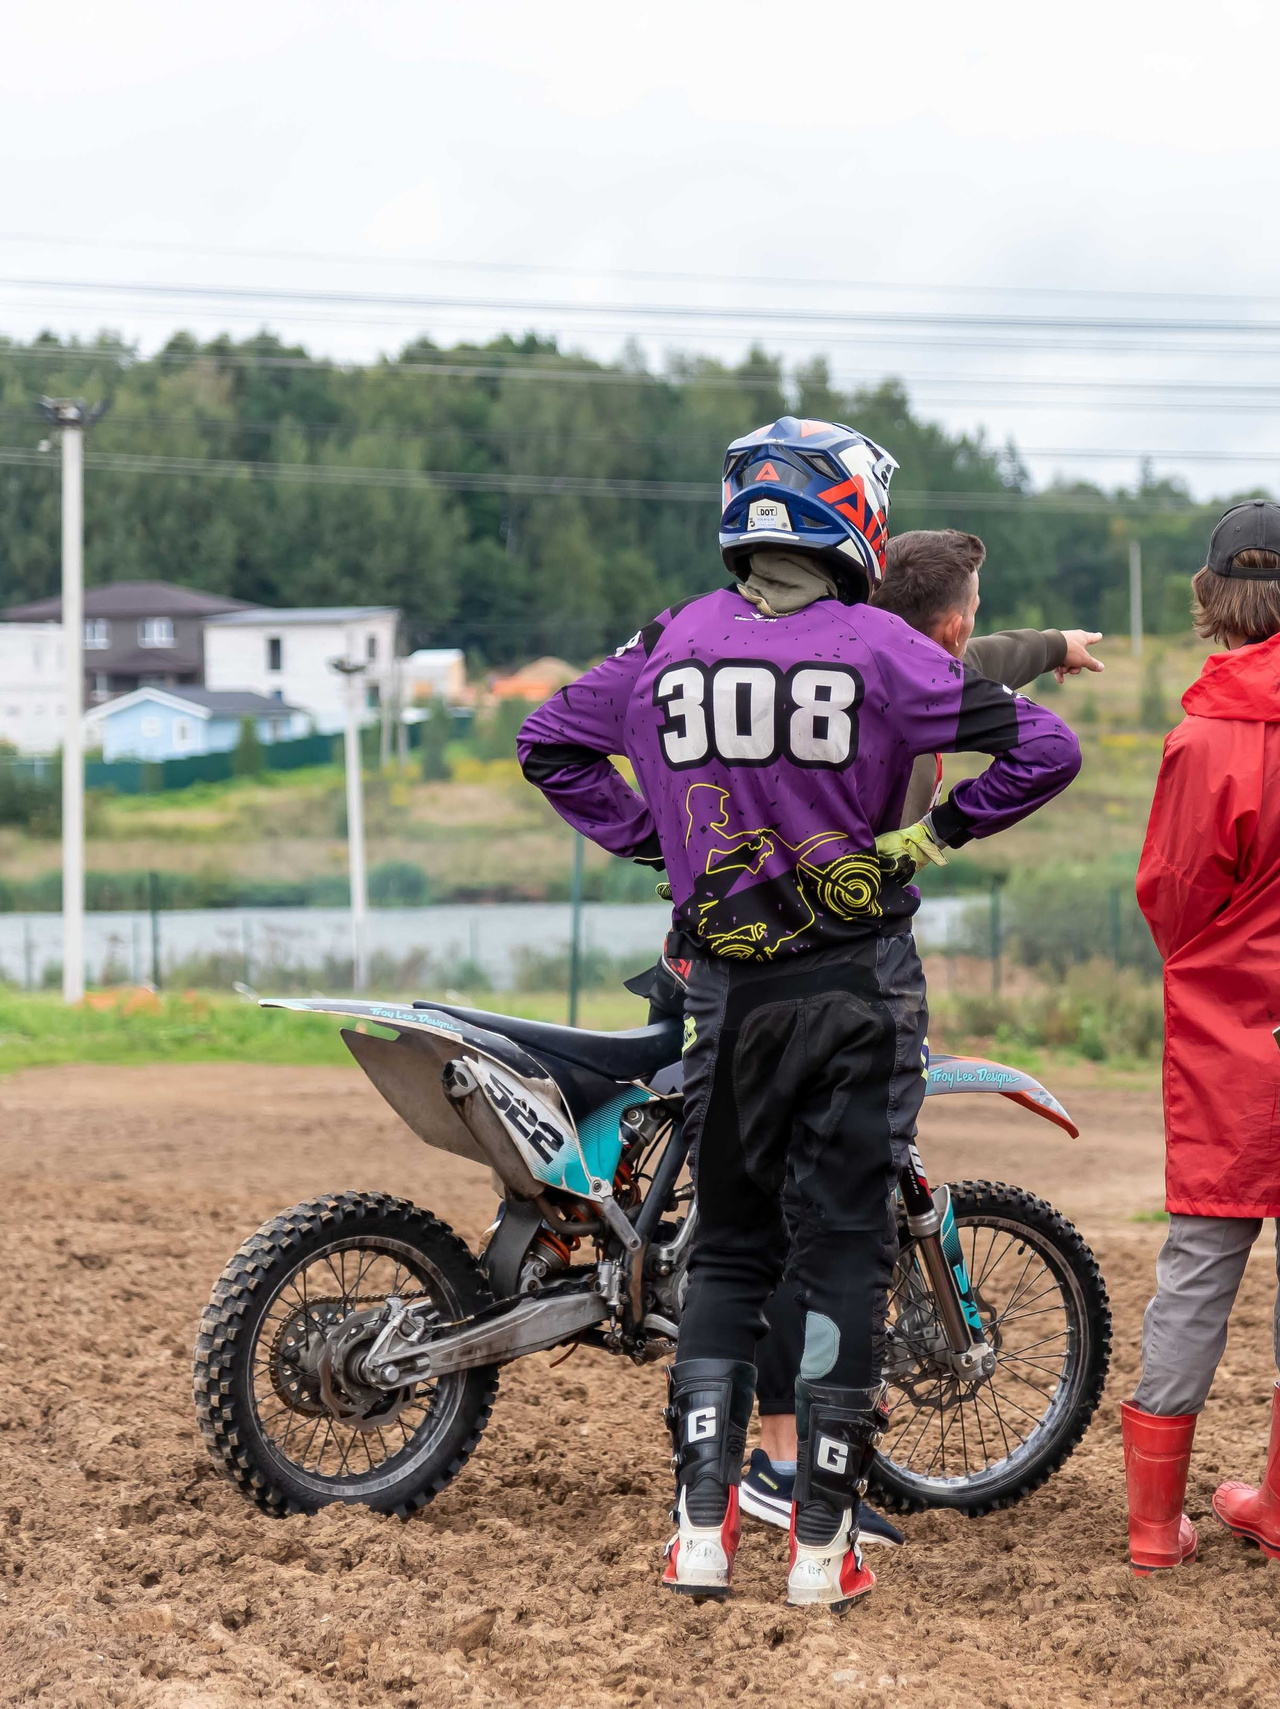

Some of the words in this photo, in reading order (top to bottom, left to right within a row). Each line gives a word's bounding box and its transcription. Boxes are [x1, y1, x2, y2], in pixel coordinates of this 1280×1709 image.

[760, 508, 775, 516] DOT
[657, 666, 856, 764] 308
[369, 1007, 394, 1019] Troy
[395, 1010, 416, 1021] Lee
[930, 1068, 953, 1089] Troy
[956, 1068, 976, 1082] Lee
[976, 1067, 1020, 1089] Designs
[484, 1072, 565, 1166] 522
[688, 1406, 717, 1443] G
[817, 1436, 849, 1475] G
